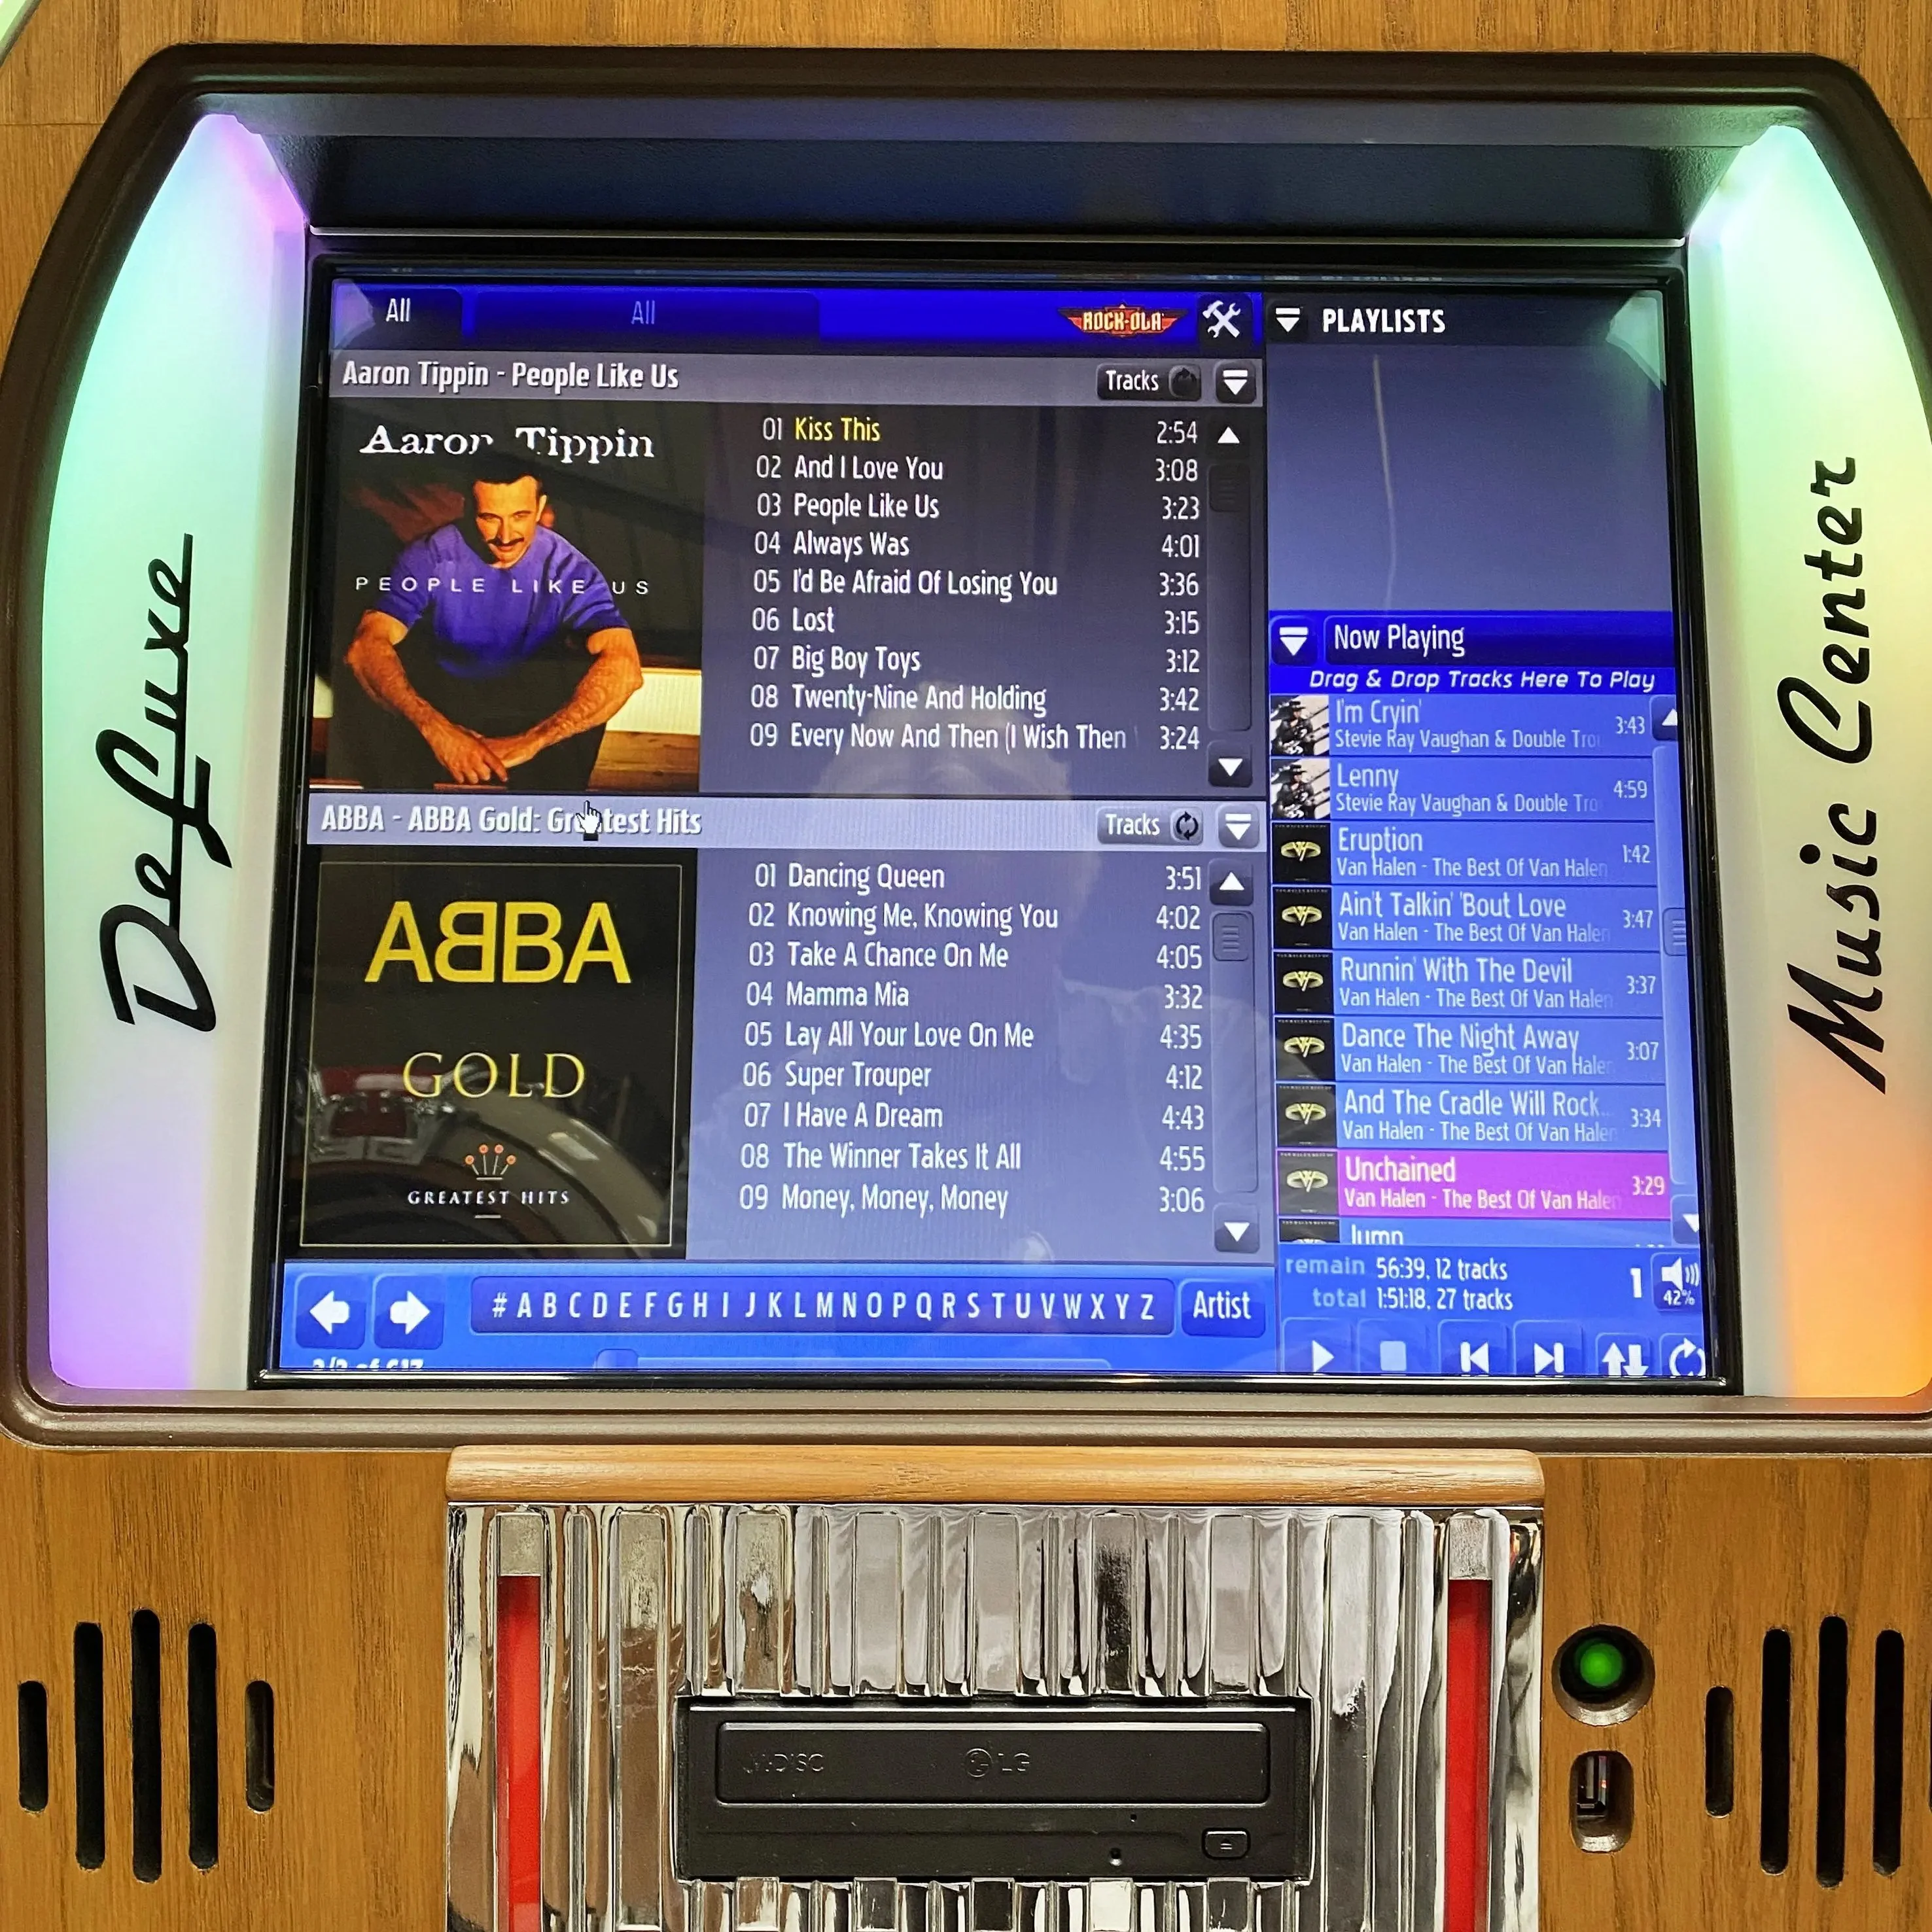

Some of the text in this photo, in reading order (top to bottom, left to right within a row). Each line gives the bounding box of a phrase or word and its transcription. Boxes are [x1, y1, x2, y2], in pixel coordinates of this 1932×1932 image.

[385, 297, 411, 323] All
[631, 300, 656, 325] All
[1323, 308, 1446, 333] PLAYLISTS
[342, 360, 678, 395] Aaron Tippin People Like Us
[1105, 369, 1159, 391] Tracks
[795, 415, 881, 442] Kiss This
[1157, 420, 1198, 444] 2:54
[794, 454, 943, 480] And I Love You
[1155, 458, 1198, 482] 3:08
[794, 492, 940, 525] People Like Us
[1162, 495, 1200, 520] 3:23
[793, 529, 910, 563] Always Was
[1161, 534, 1199, 558] 4:01
[355, 576, 650, 595] PEOPLE LIKE US
[793, 567, 1058, 603] I'd Be Afraid Of Losing You
[1159, 572, 1199, 597] 3:36
[792, 606, 835, 633] Lost
[1165, 610, 1200, 635] 3:15
[1335, 623, 1466, 658] Now Playing
[792, 644, 921, 679] Big Boy Toys
[1166, 648, 1200, 673] 3:12
[1309, 669, 1655, 694] Drag & Drop Tracks Here To Play
[791, 683, 1047, 719] Twenty-Nine And Holding
[1159, 687, 1200, 712] 3:42
[1336, 697, 1422, 731] I'm Cryin'
[1615, 716, 1645, 735] 3:43
[1159, 725, 1200, 750] 3:24
[1335, 728, 1566, 754] Stevie Ray Vaughan & Double
[1337, 762, 1399, 794] Lenny
[1776, 456, 1886, 1095] Music Center
[1613, 780, 1648, 799] 4:59
[321, 804, 703, 835] ABBA ABBA Gold: Grtest Hits
[1105, 813, 1161, 836] Tracks
[1338, 826, 1423, 859] Eruption
[1622, 844, 1651, 864] 1:42
[788, 861, 945, 897] Dancing Queen
[1339, 890, 1383, 918] Ain't
[1390, 890, 1454, 917] Talkin'
[1518, 892, 1566, 918] Love
[788, 900, 1058, 937] Knowing Me, Knowing You
[1623, 909, 1654, 928] 3:47
[364, 900, 631, 984] ABBA
[787, 940, 1009, 968] Take A Chance On Me
[1341, 955, 1572, 984] Runnin' With The Devil
[786, 980, 909, 1007] Mamma Mia
[1626, 975, 1657, 994] 3:37
[785, 1020, 1034, 1055] Lay All Your Love On Me
[1342, 1022, 1580, 1059] Dance The Night Away
[1626, 1041, 1659, 1061] 3:07
[402, 1052, 585, 1098] GOLD
[784, 1060, 932, 1096] Super Trouper
[784, 1101, 943, 1128] I Have A Dream
[1344, 1088, 1384, 1114] And
[1392, 1088, 1432, 1115] The
[1439, 1089, 1503, 1116] Cradle
[1509, 1089, 1545, 1116] Will
[1630, 1108, 1662, 1128] 3:34
[783, 1141, 1021, 1170] The Winner Takes It All
[1345, 1155, 1456, 1183] Unchained
[407, 1190, 569, 1205] GREATEST HITS
[1632, 1175, 1666, 1196] 3:29
[782, 1183, 1009, 1220] Money, Money, Money
[1286, 1256, 1365, 1275] remain
[1435, 1257, 1452, 1280] 12
[1457, 1257, 1508, 1282] tracks
[1630, 1267, 1642, 1298] 1
[1193, 1290, 1252, 1320] Artist
[1312, 1288, 1367, 1308] total
[1436, 1287, 1457, 1310] 27
[1462, 1287, 1513, 1311] tracks
[1663, 1289, 1696, 1307] 42%
